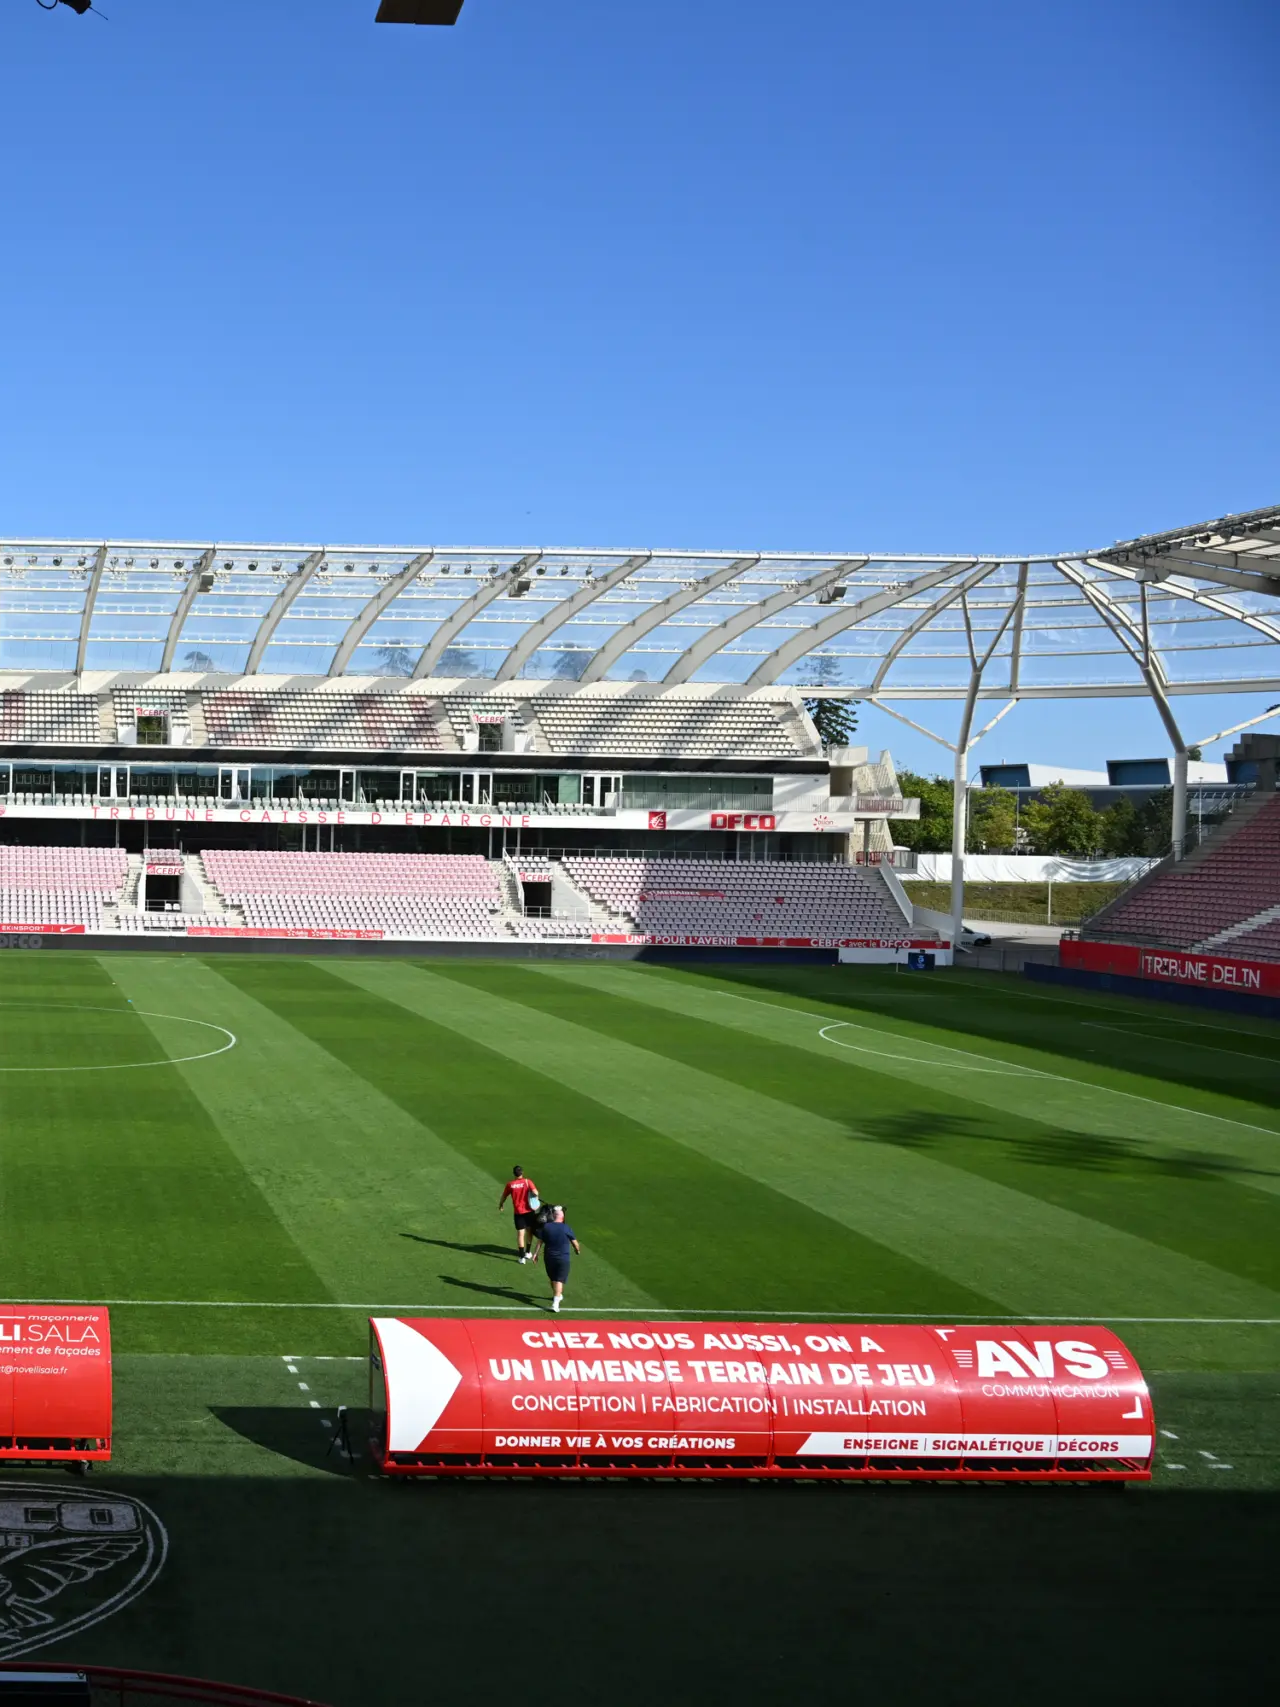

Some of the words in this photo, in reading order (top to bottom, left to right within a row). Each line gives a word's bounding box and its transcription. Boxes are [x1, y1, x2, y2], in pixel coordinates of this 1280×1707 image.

[92, 807, 214, 821] TRIBUNE
[240, 810, 345, 824] CAISSE
[372, 812, 382, 824] D
[405, 813, 530, 827] EPARGNE
[710, 814, 776, 830] DFCO
[626, 935, 652, 944] UNIS
[656, 936, 686, 944] POUR
[689, 936, 737, 946] L'AVENIR
[810, 938, 846, 948] CEBFC
[880, 939, 911, 948] DFCO
[1145, 956, 1208, 981] TRIBUNE
[28, 1315, 100, 1323] maçonnerie
[522, 1331, 604, 1349] CHEZ
[607, 1332, 696, 1350] NOUS
[703, 1334, 802, 1356] AUSSI,
[804, 1336, 853, 1352] ON
[861, 1336, 886, 1352] A
[36, 1346, 51, 1355] de
[54, 1346, 100, 1358] façades
[976, 1340, 1108, 1379] AVS
[488, 1358, 534, 1381] UN
[542, 1359, 684, 1382] IMMENSE
[686, 1360, 824, 1385] TERRAIN
[828, 1363, 874, 1386] DE
[876, 1364, 936, 1386] JEU
[982, 1384, 1120, 1398] COMMUNICATION
[512, 1394, 636, 1412] CONCEPTION
[652, 1396, 778, 1414] FABRICATION
[793, 1398, 926, 1416] INSTALLATION
[495, 1436, 561, 1448] DONNER
[566, 1436, 591, 1448] VIE
[595, 1433, 608, 1448] À
[614, 1436, 644, 1448] VOS
[648, 1434, 736, 1450] CRÉATIONS
[843, 1438, 918, 1450] ENSEIGNE
[932, 1438, 1044, 1452] SIGNALÉTIQUE
[1058, 1439, 1119, 1452] DÉCORS
